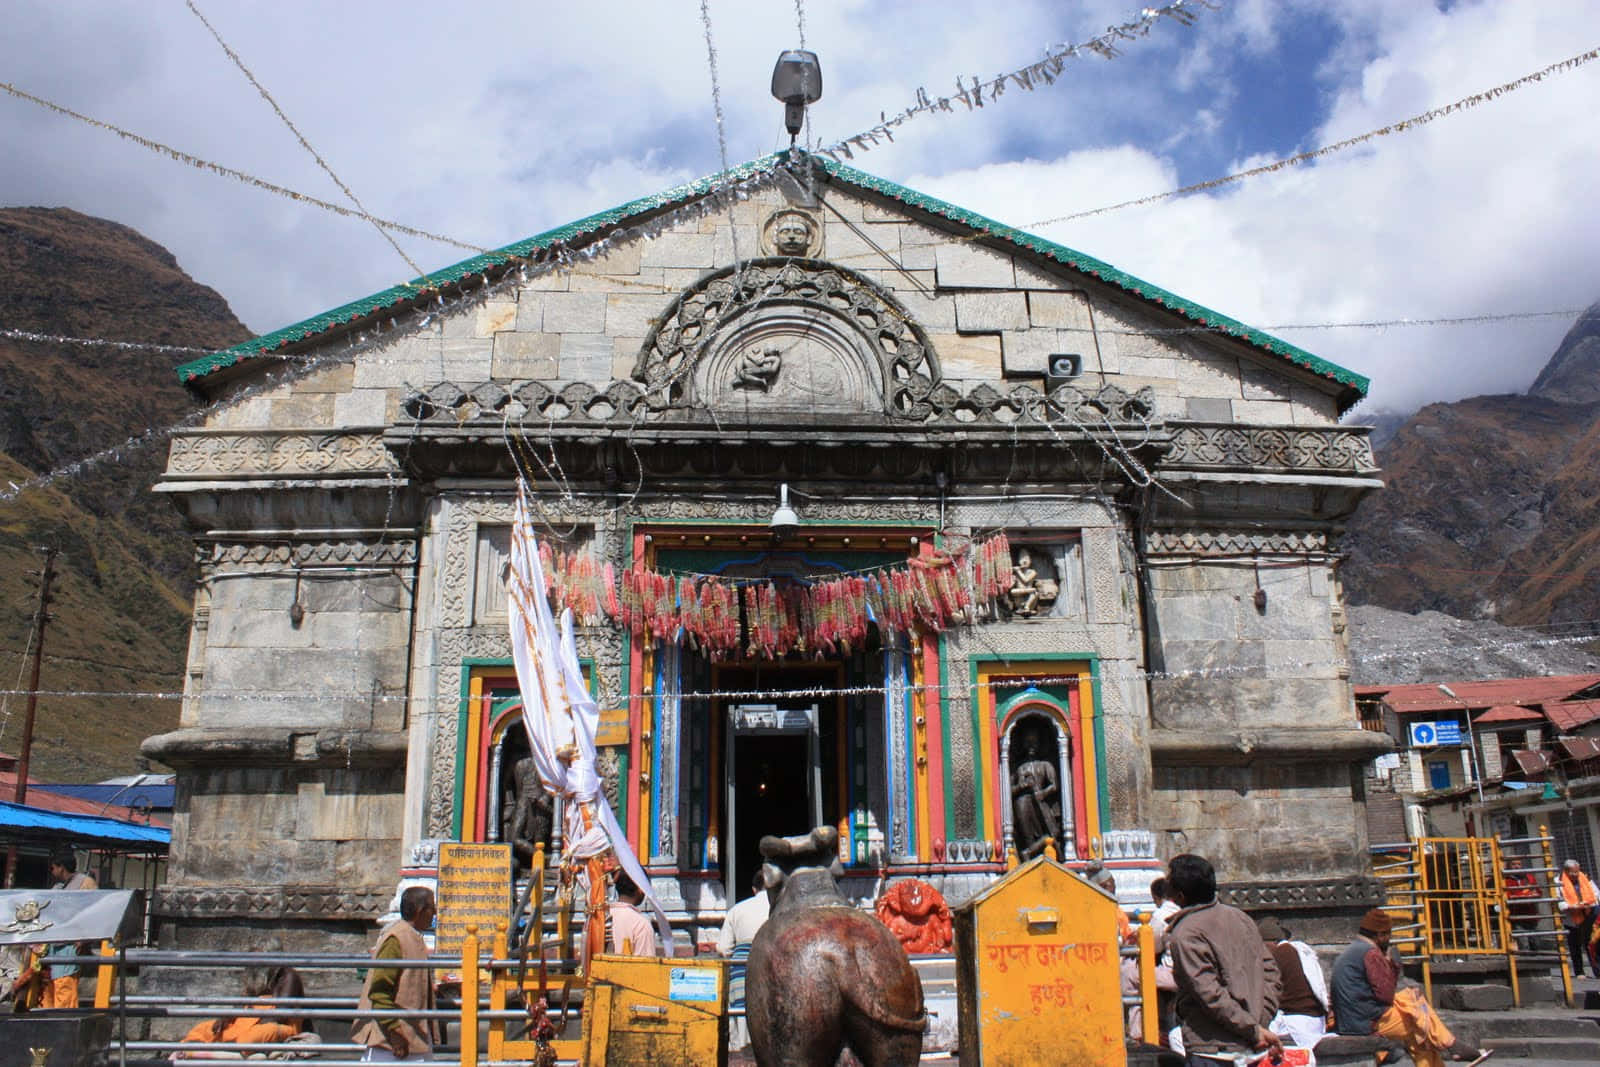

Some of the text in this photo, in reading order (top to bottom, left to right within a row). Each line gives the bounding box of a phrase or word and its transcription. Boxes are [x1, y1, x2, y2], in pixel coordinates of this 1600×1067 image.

[986, 943, 1108, 973] गुप्त दान पात्र
